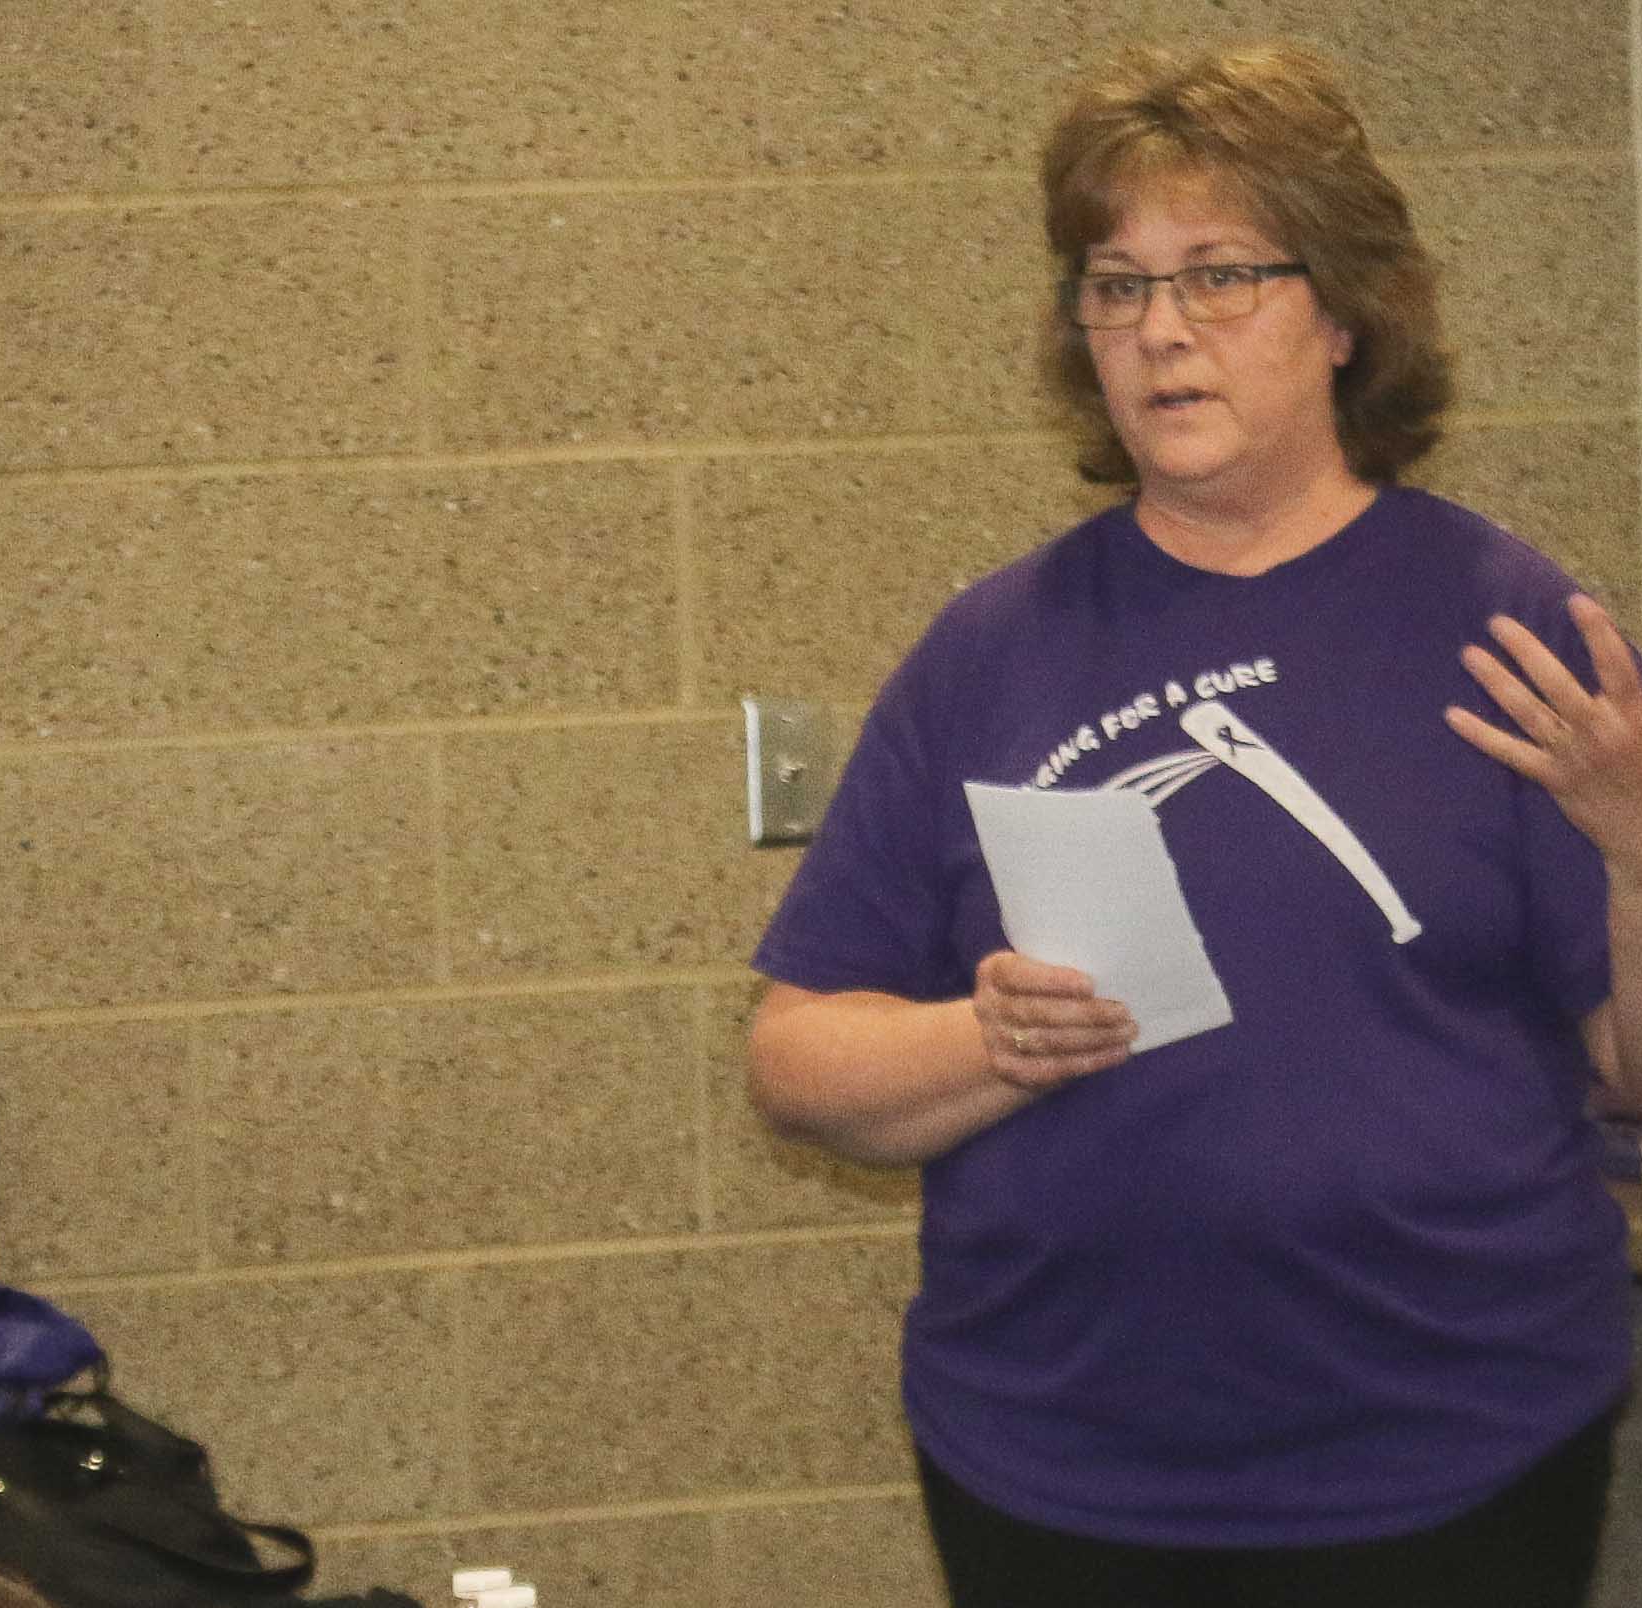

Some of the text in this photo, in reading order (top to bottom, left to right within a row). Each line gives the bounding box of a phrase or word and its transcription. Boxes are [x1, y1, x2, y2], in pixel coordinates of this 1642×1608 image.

[1101, 693, 1161, 741] FOR
[1165, 680, 1188, 708] A
[1194, 657, 1278, 700] CURE
